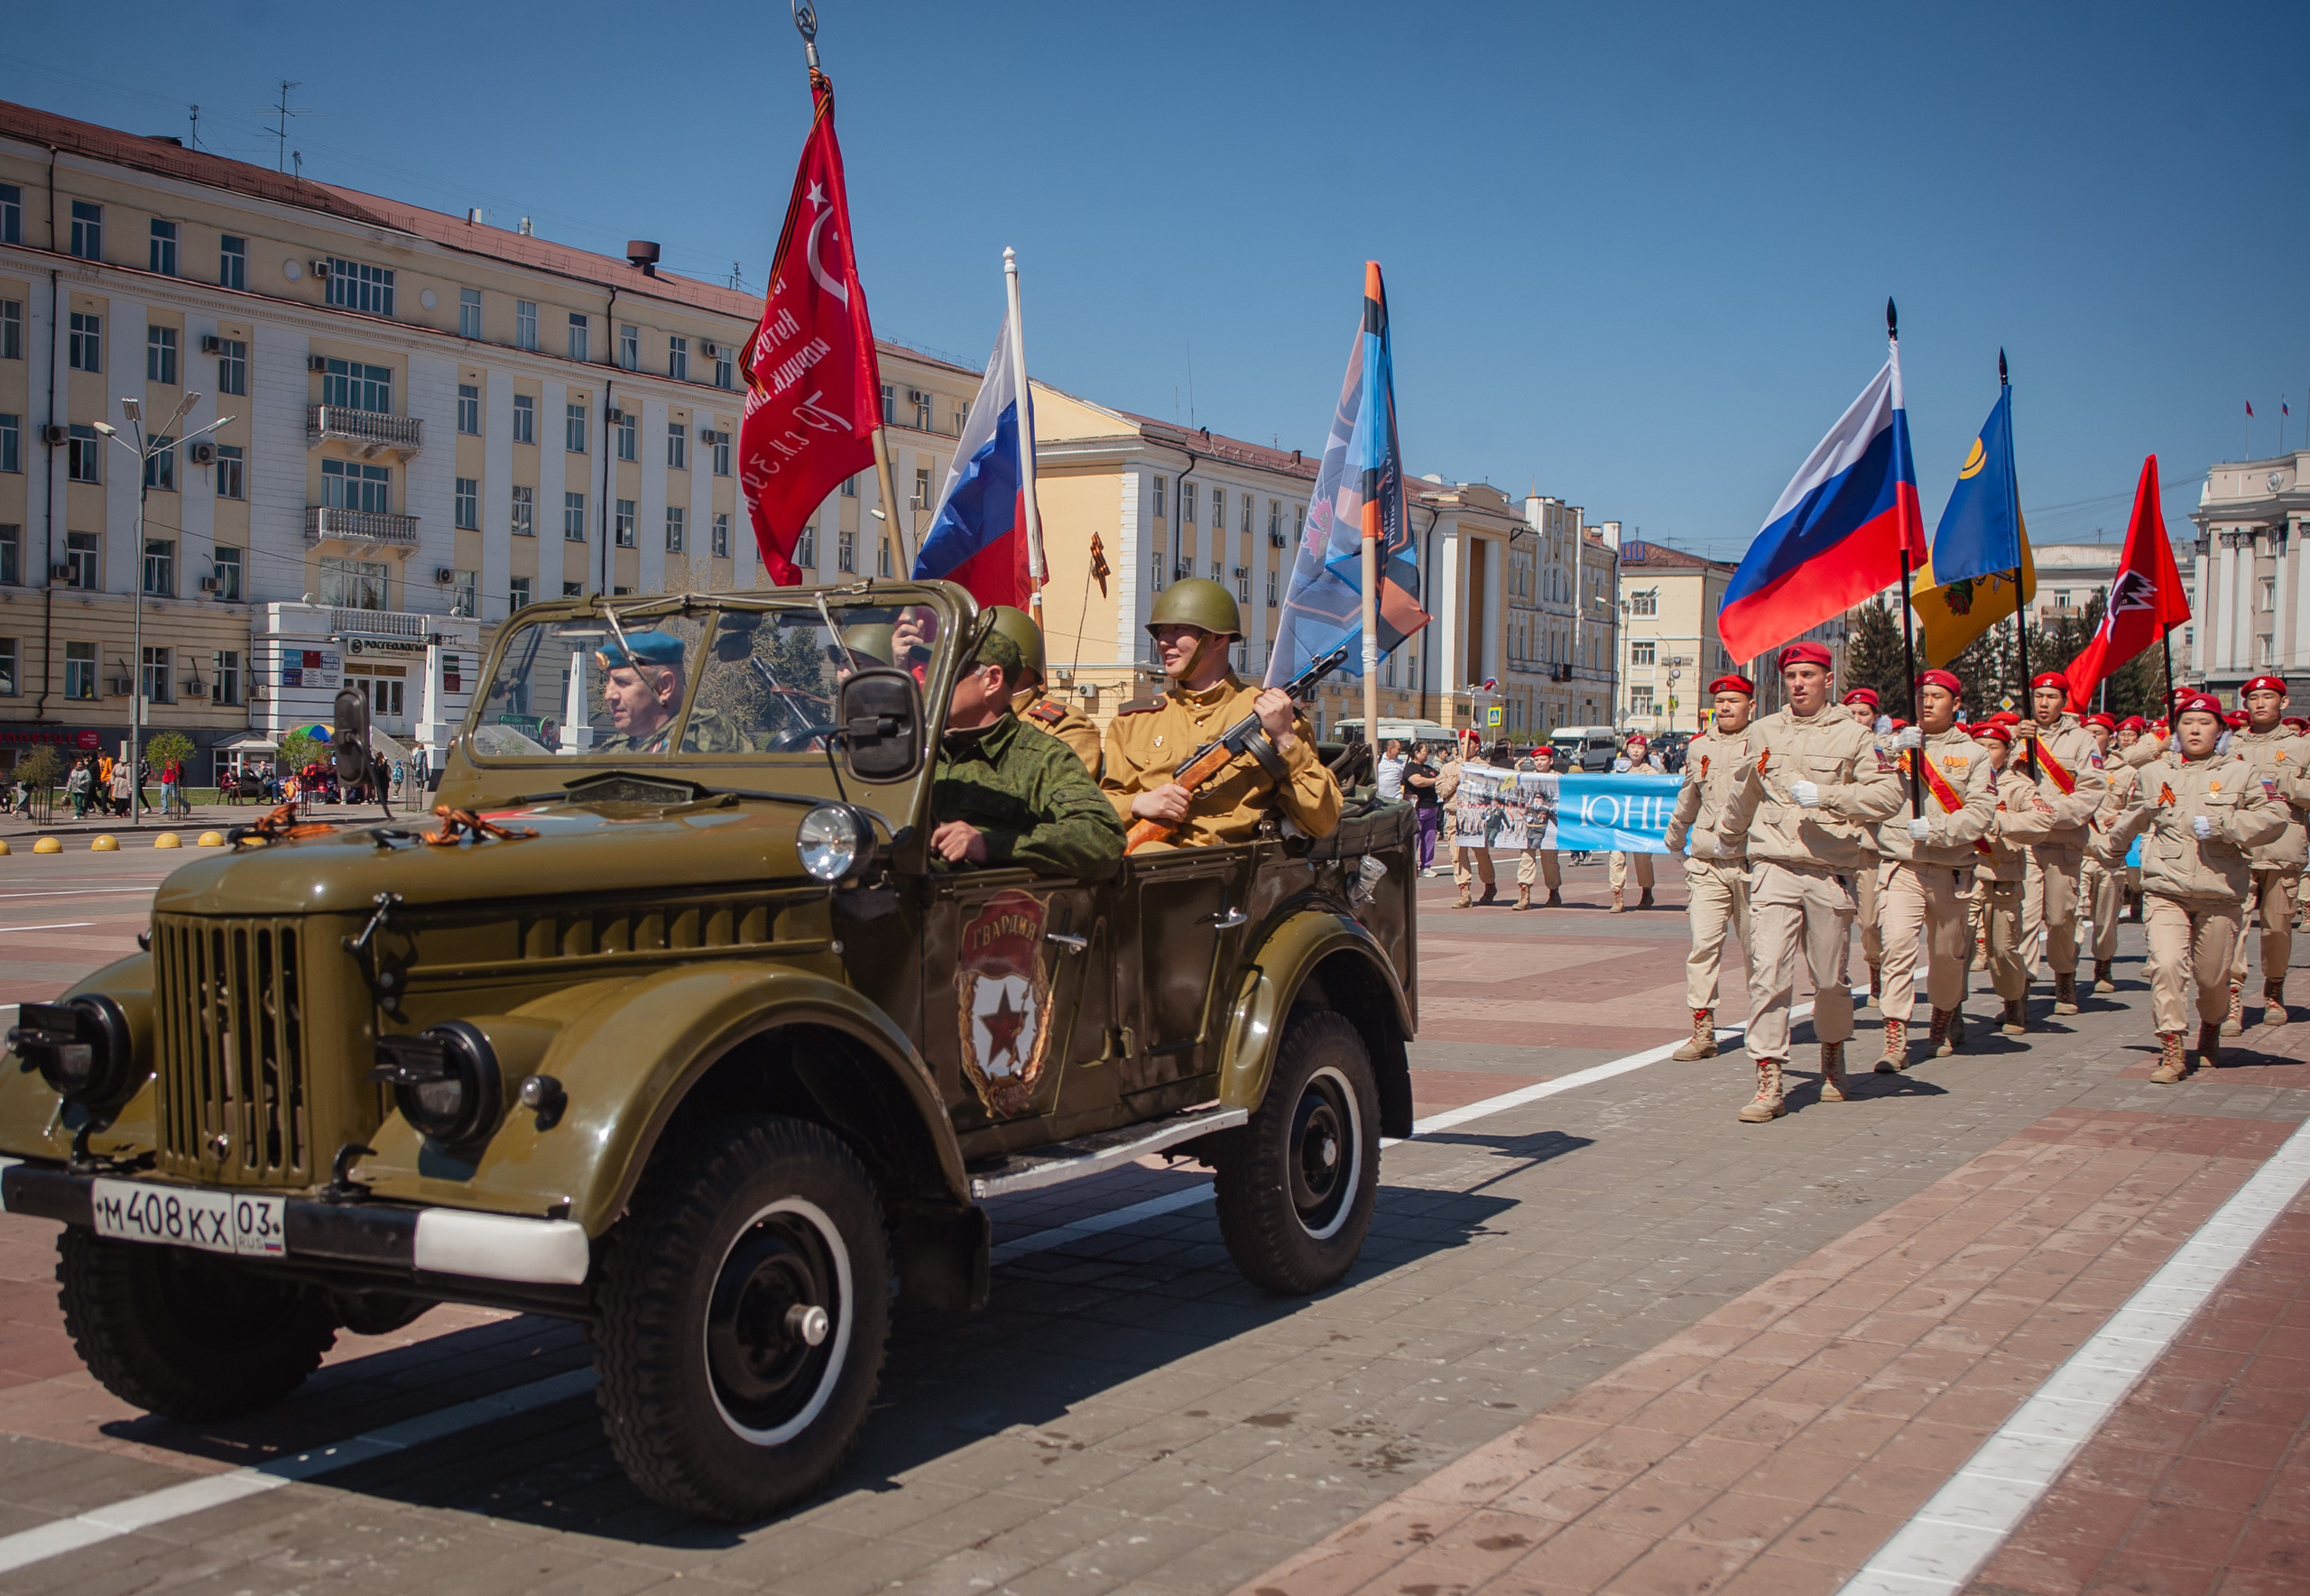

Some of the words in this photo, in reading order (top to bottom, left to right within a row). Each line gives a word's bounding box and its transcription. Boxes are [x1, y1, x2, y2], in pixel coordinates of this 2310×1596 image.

[0, 732, 73, 744] ппетит
[972, 914, 1037, 950] ГВАРДИЯ
[237, 1201, 270, 1235] 03
